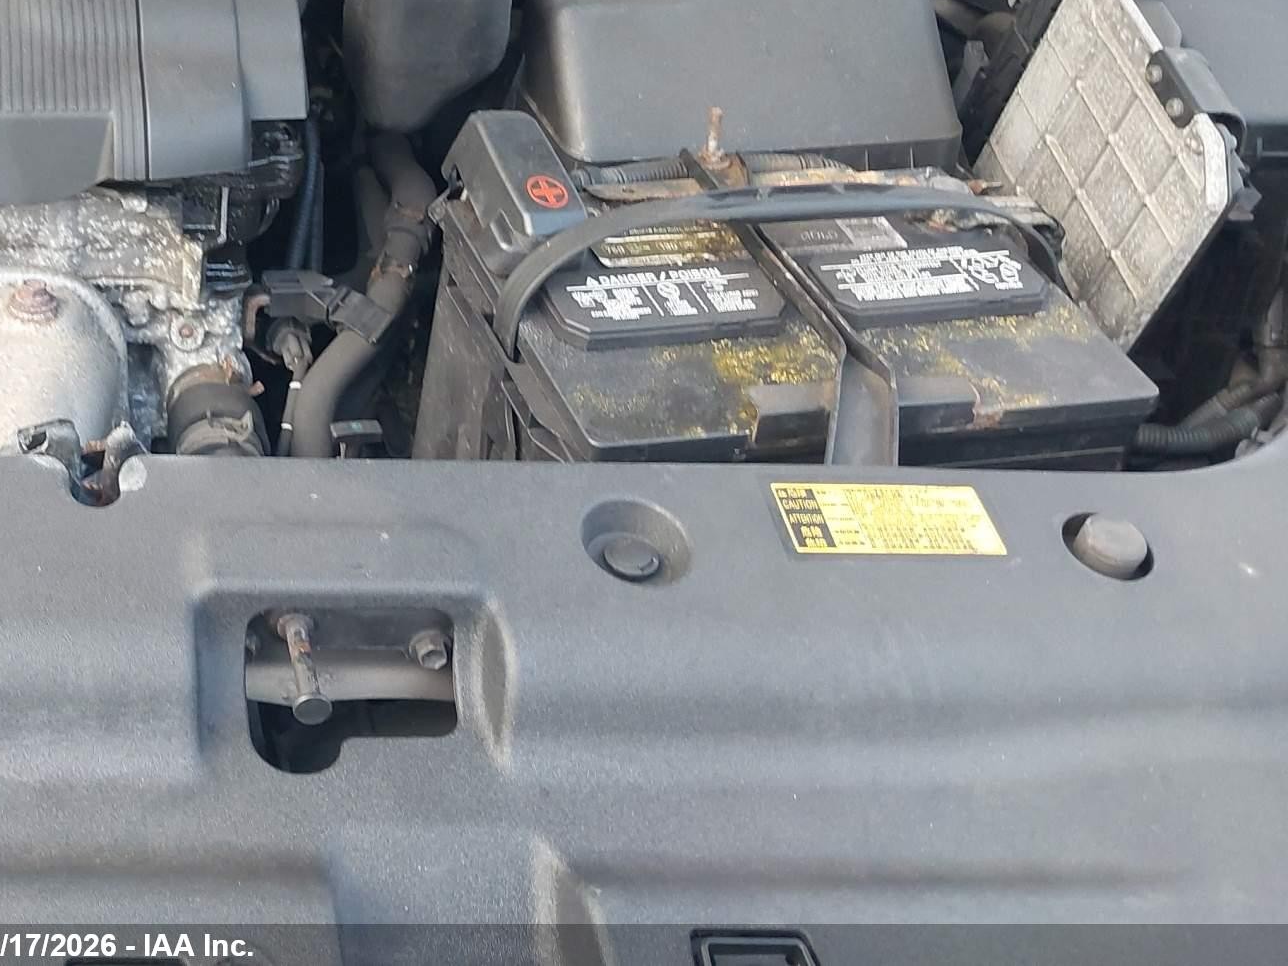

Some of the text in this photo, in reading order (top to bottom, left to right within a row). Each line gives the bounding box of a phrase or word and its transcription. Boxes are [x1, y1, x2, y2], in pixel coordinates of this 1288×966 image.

[598, 270, 657, 286] DANGER
[669, 266, 722, 281] POISON
[782, 499, 820, 511] CAUTION
[788, 513, 826, 524] ATTENTION
